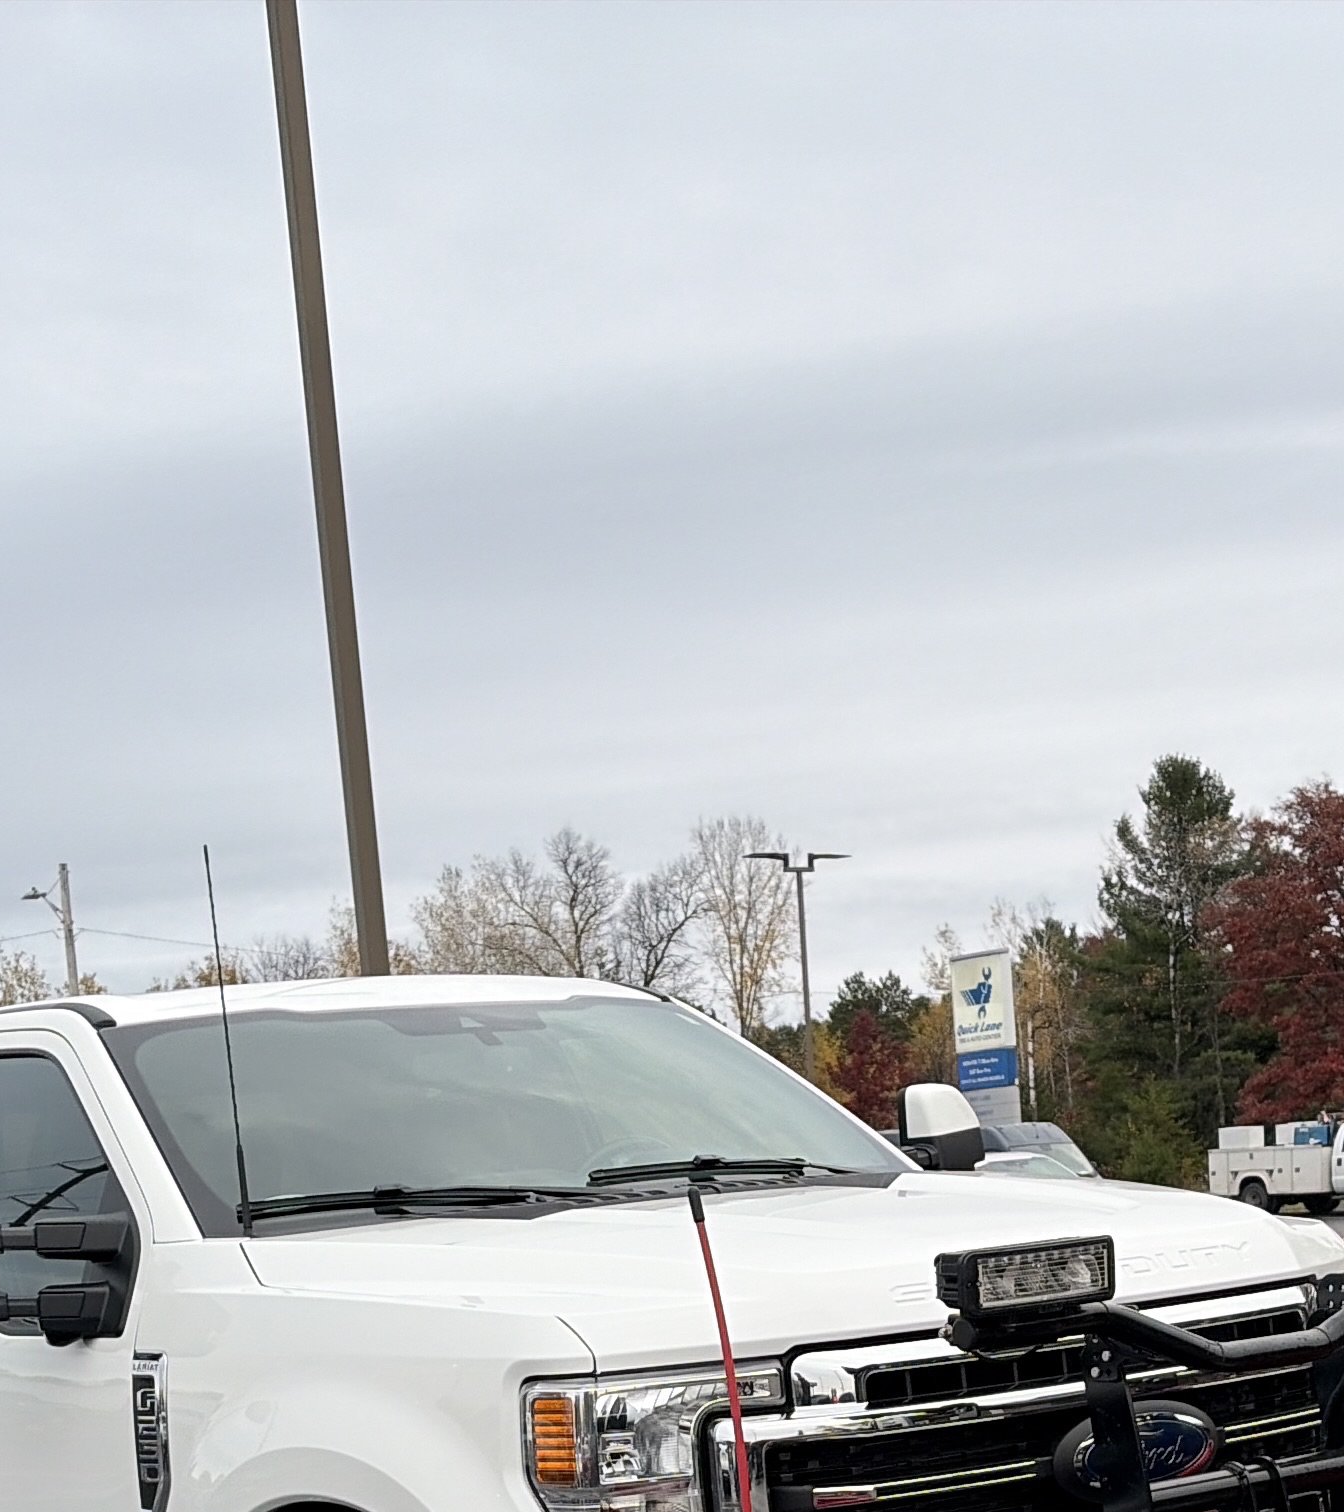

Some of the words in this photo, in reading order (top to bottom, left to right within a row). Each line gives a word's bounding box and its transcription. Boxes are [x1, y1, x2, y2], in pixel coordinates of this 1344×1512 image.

[957, 1023, 979, 1036] Quick
[980, 1021, 1003, 1032] Lane
[1119, 1240, 1248, 1275] DUTY
[133, 1362, 158, 1371] LARIAT
